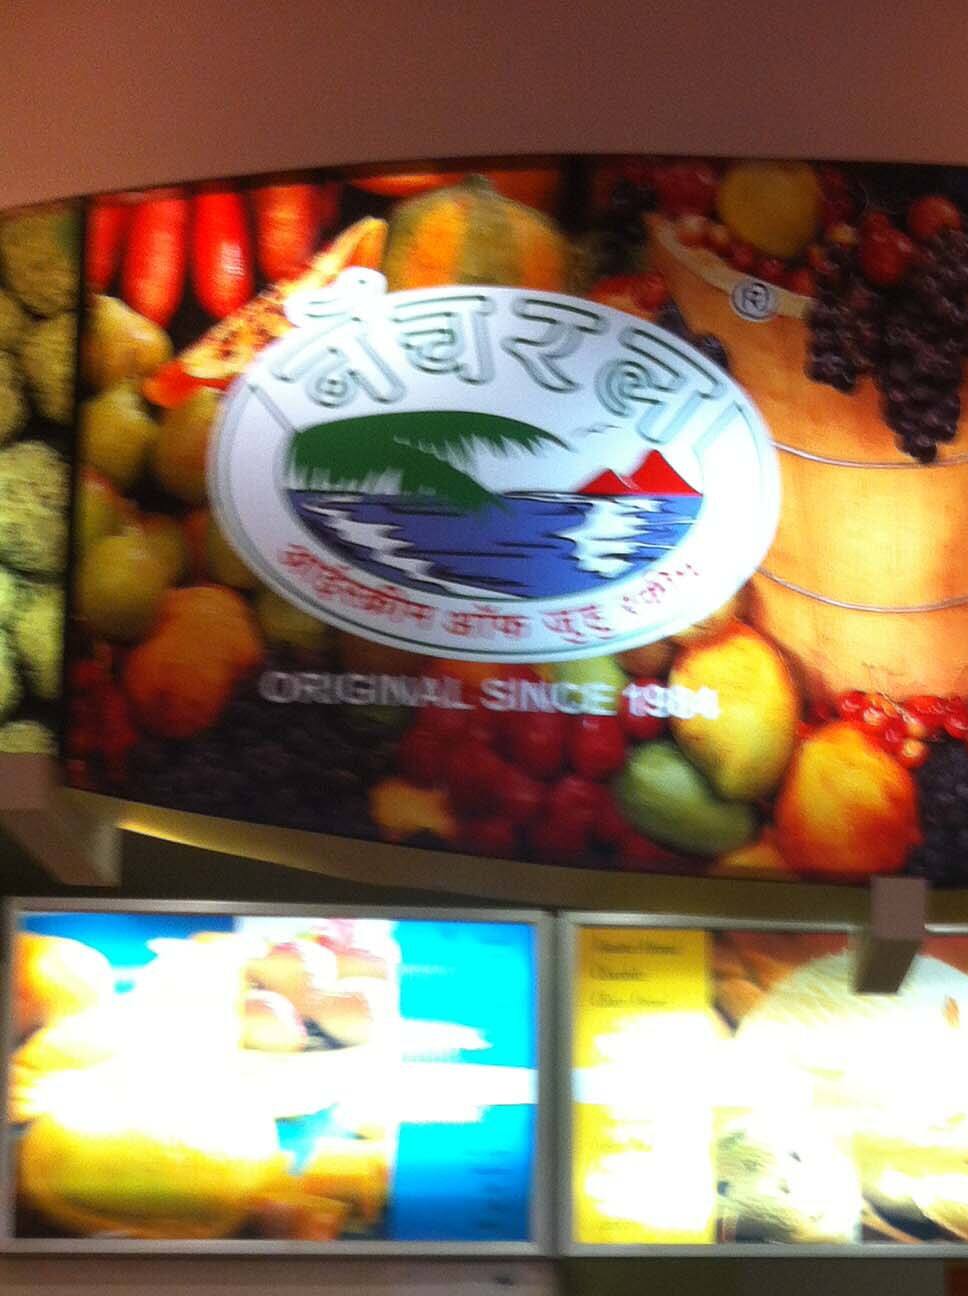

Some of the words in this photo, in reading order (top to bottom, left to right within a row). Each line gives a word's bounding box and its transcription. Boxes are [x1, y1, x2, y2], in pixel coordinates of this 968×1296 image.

[258, 671, 475, 711] ORIGINAL
[480, 679, 617, 717] SINCE
[622, 682, 721, 721] 1984
